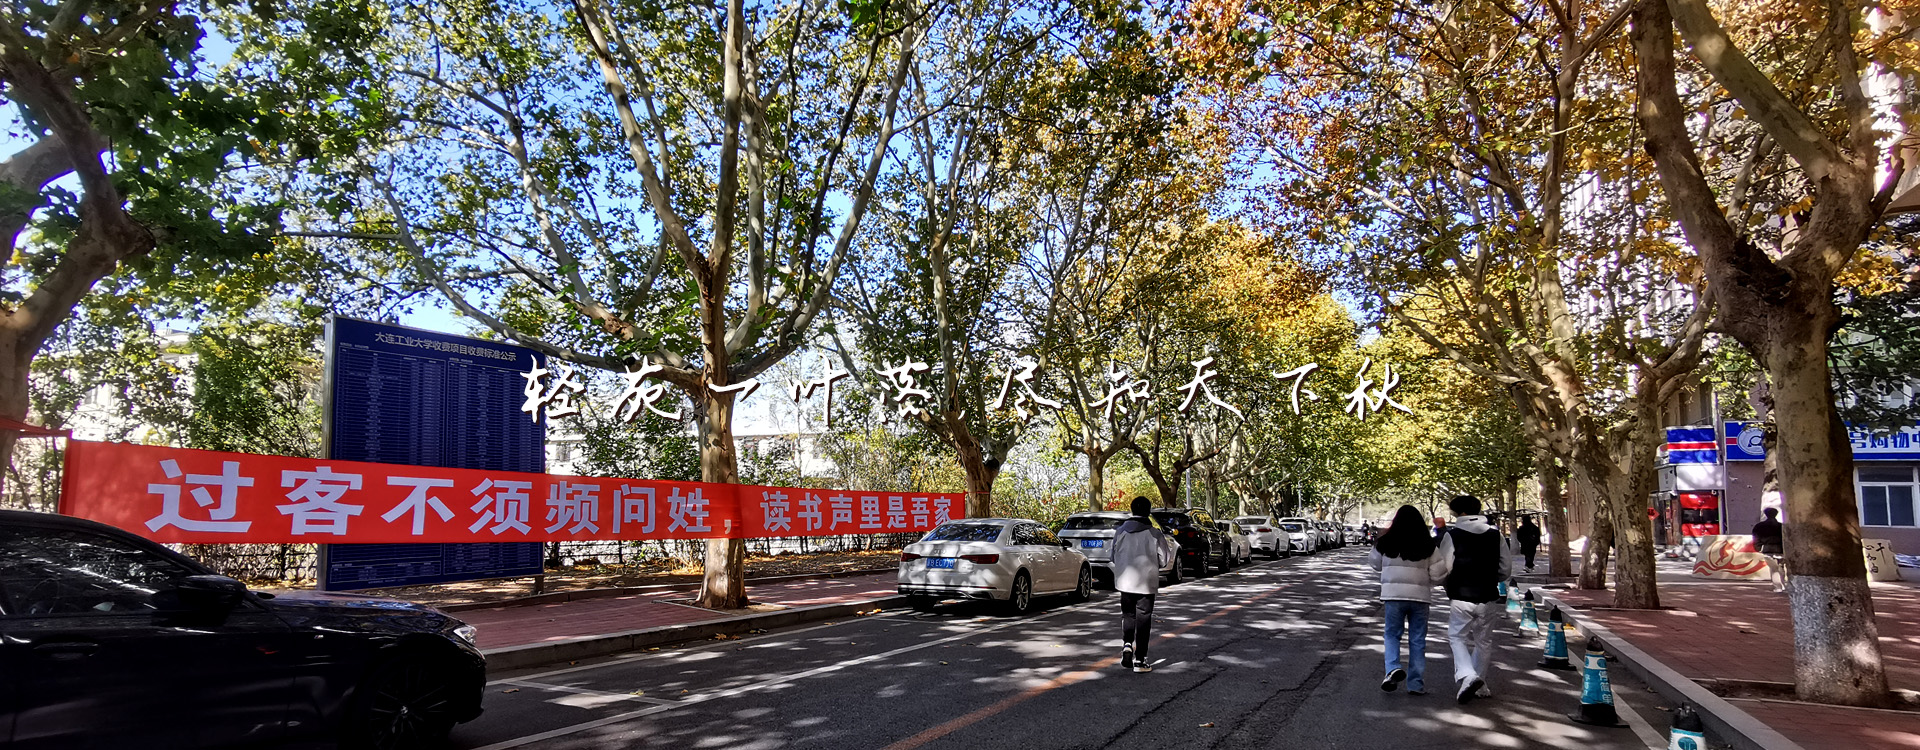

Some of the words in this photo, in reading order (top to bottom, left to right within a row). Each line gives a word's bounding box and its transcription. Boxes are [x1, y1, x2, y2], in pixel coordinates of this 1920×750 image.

[375, 331, 517, 361] 大连工业大学收费项目收费标准公示
